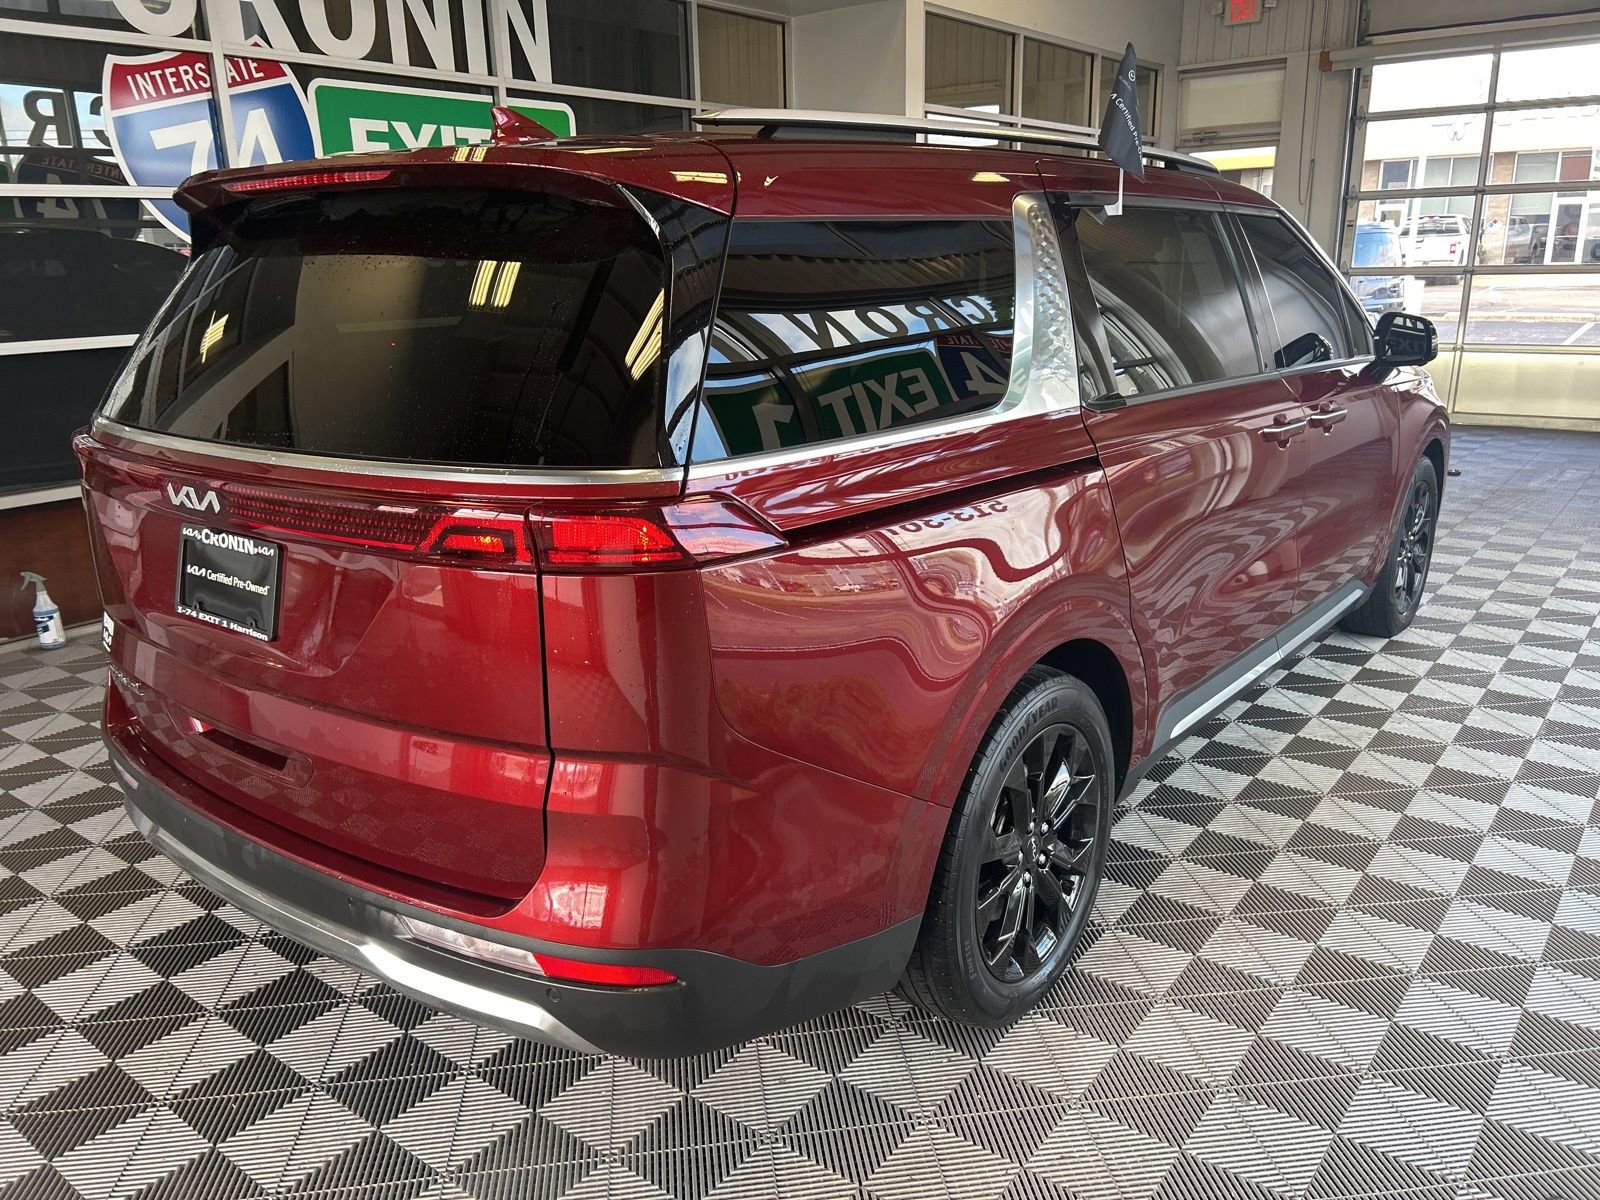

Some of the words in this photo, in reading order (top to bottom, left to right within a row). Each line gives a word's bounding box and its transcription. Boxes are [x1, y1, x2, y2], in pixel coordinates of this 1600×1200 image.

[126, 57, 265, 101] INTERSATE
[167, 482, 220, 514] KIA
[201, 529, 255, 555] CRONIN
[187, 564, 207, 577] KIA
[206, 569, 233, 586] Certified
[233, 577, 269, 595] Pre-Owned
[176, 605, 197, 618] I-74
[198, 612, 221, 625] EXIT
[222, 620, 229, 628] 1
[229, 622, 269, 641] Harrison
